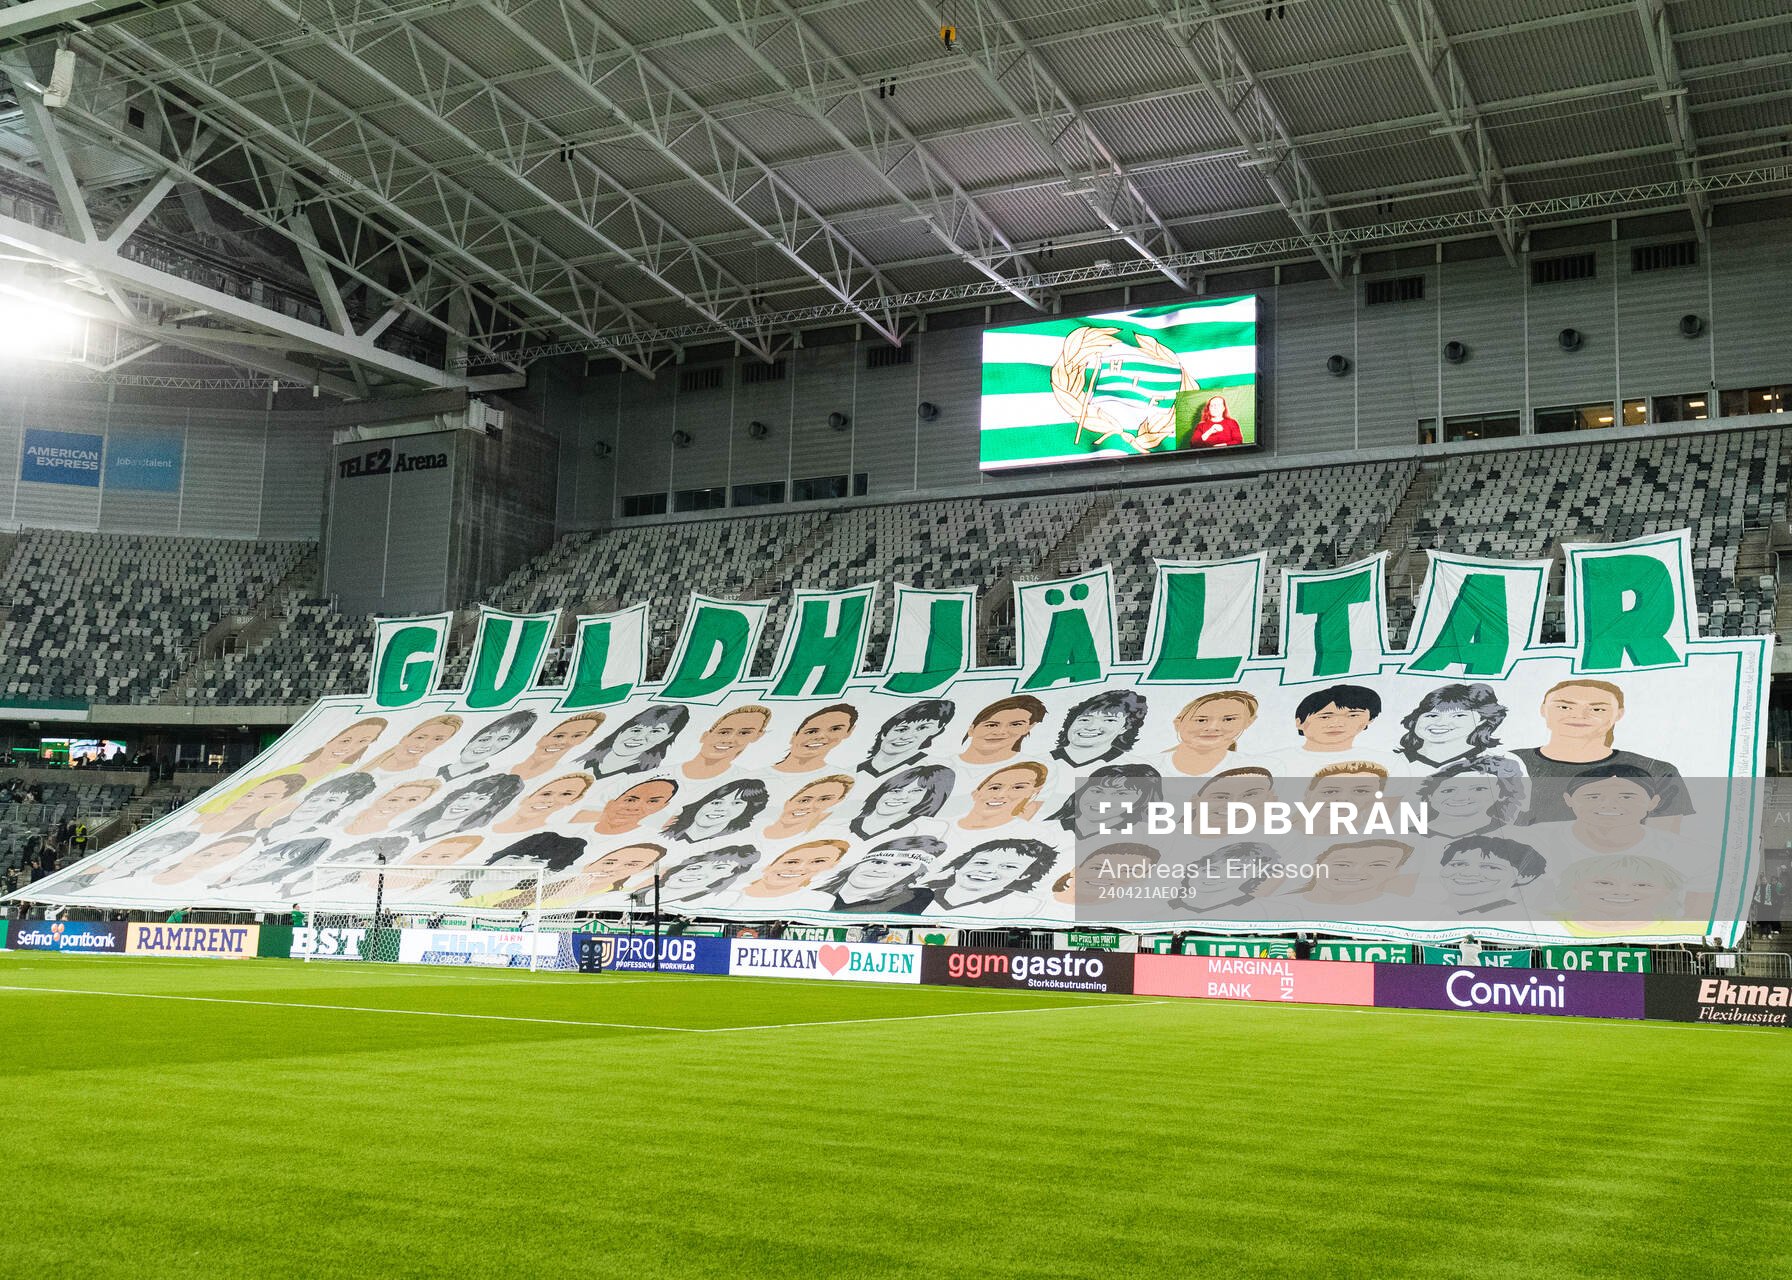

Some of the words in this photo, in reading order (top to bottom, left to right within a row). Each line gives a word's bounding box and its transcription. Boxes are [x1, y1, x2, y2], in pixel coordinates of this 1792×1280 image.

[27, 446, 99, 461] AMERICAN
[36, 456, 99, 471] EXPRESS
[339, 448, 392, 478] TELE2
[393, 451, 448, 473] Arena
[17, 930, 52, 947] Sefina
[59, 930, 115, 949] pantbank
[137, 926, 248, 953] RAMIRENT
[290, 927, 366, 955] BST
[616, 961, 656, 970] PROFESSIONA
[660, 962, 695, 971] WORKWEAR
[736, 947, 818, 970] PELIKAN
[849, 951, 915, 975] BAJEN
[948, 953, 1009, 979] ggm
[1011, 952, 1104, 981] gastro
[1208, 959, 1293, 976] MARGINAL
[1442, 953, 1513, 968] SNE
[1028, 978, 1107, 992] Storköksutrustning
[1208, 982, 1252, 998] BANK
[1446, 969, 1565, 1009] Convini
[1698, 978, 1792, 1007] Ekma
[1699, 1006, 1788, 1023] Flexibussitet
